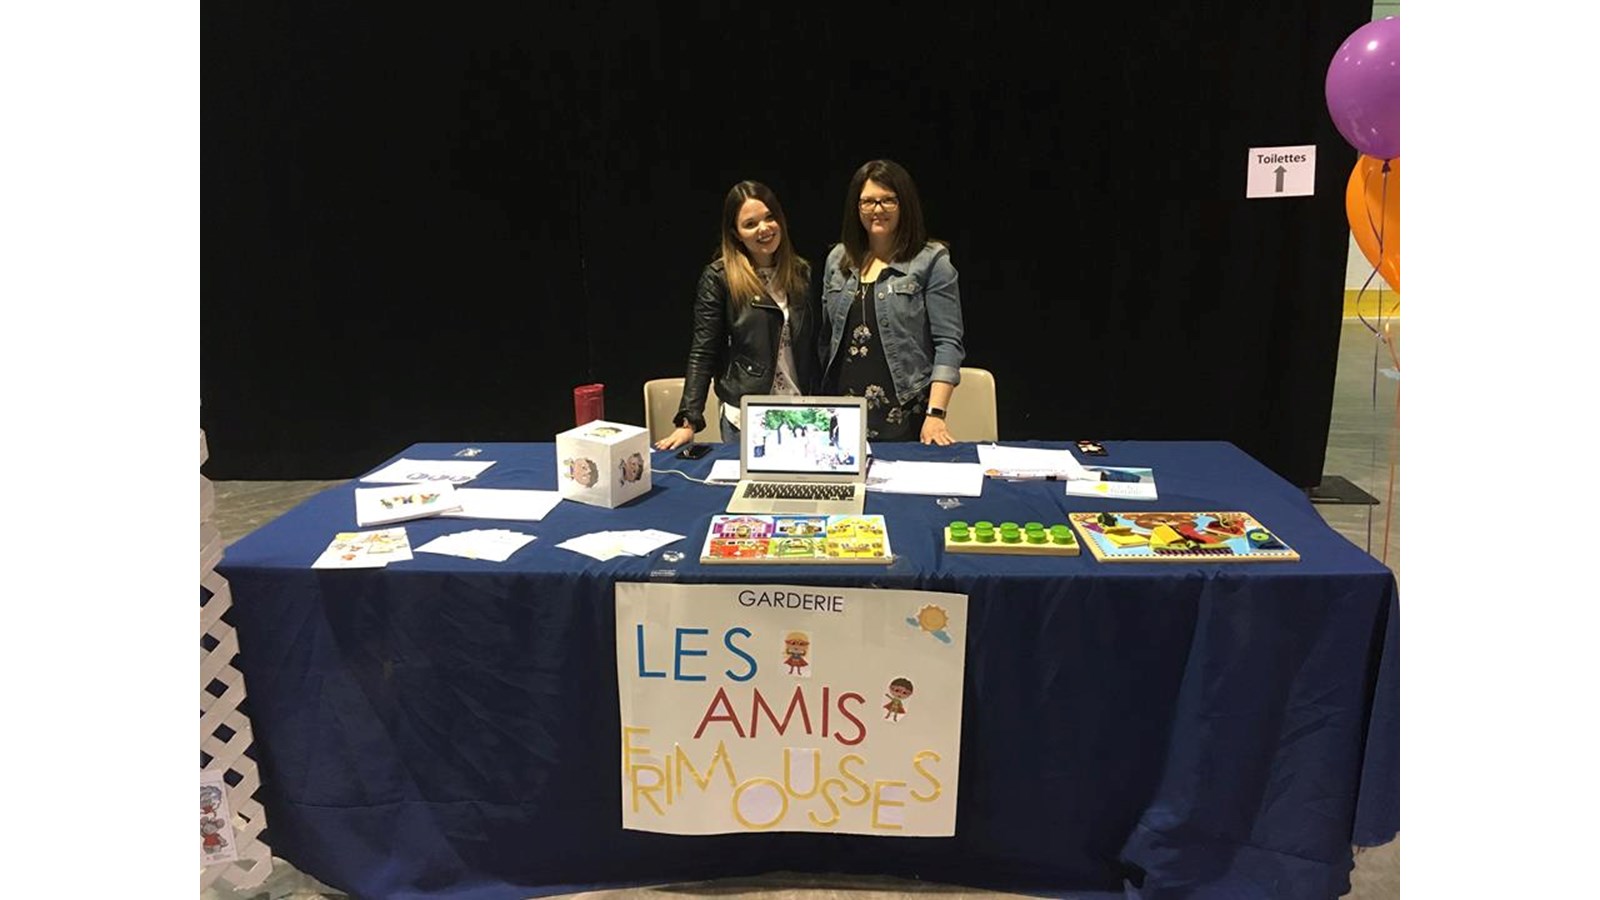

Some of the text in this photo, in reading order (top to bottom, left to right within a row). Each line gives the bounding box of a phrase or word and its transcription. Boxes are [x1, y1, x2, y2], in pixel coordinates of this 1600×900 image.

[1257, 154, 1307, 164] Toilettes
[738, 590, 844, 612] GARDERIE
[636, 624, 758, 682] LES
[693, 686, 866, 745] AMIS
[624, 726, 941, 830] FRIMOUSSES
